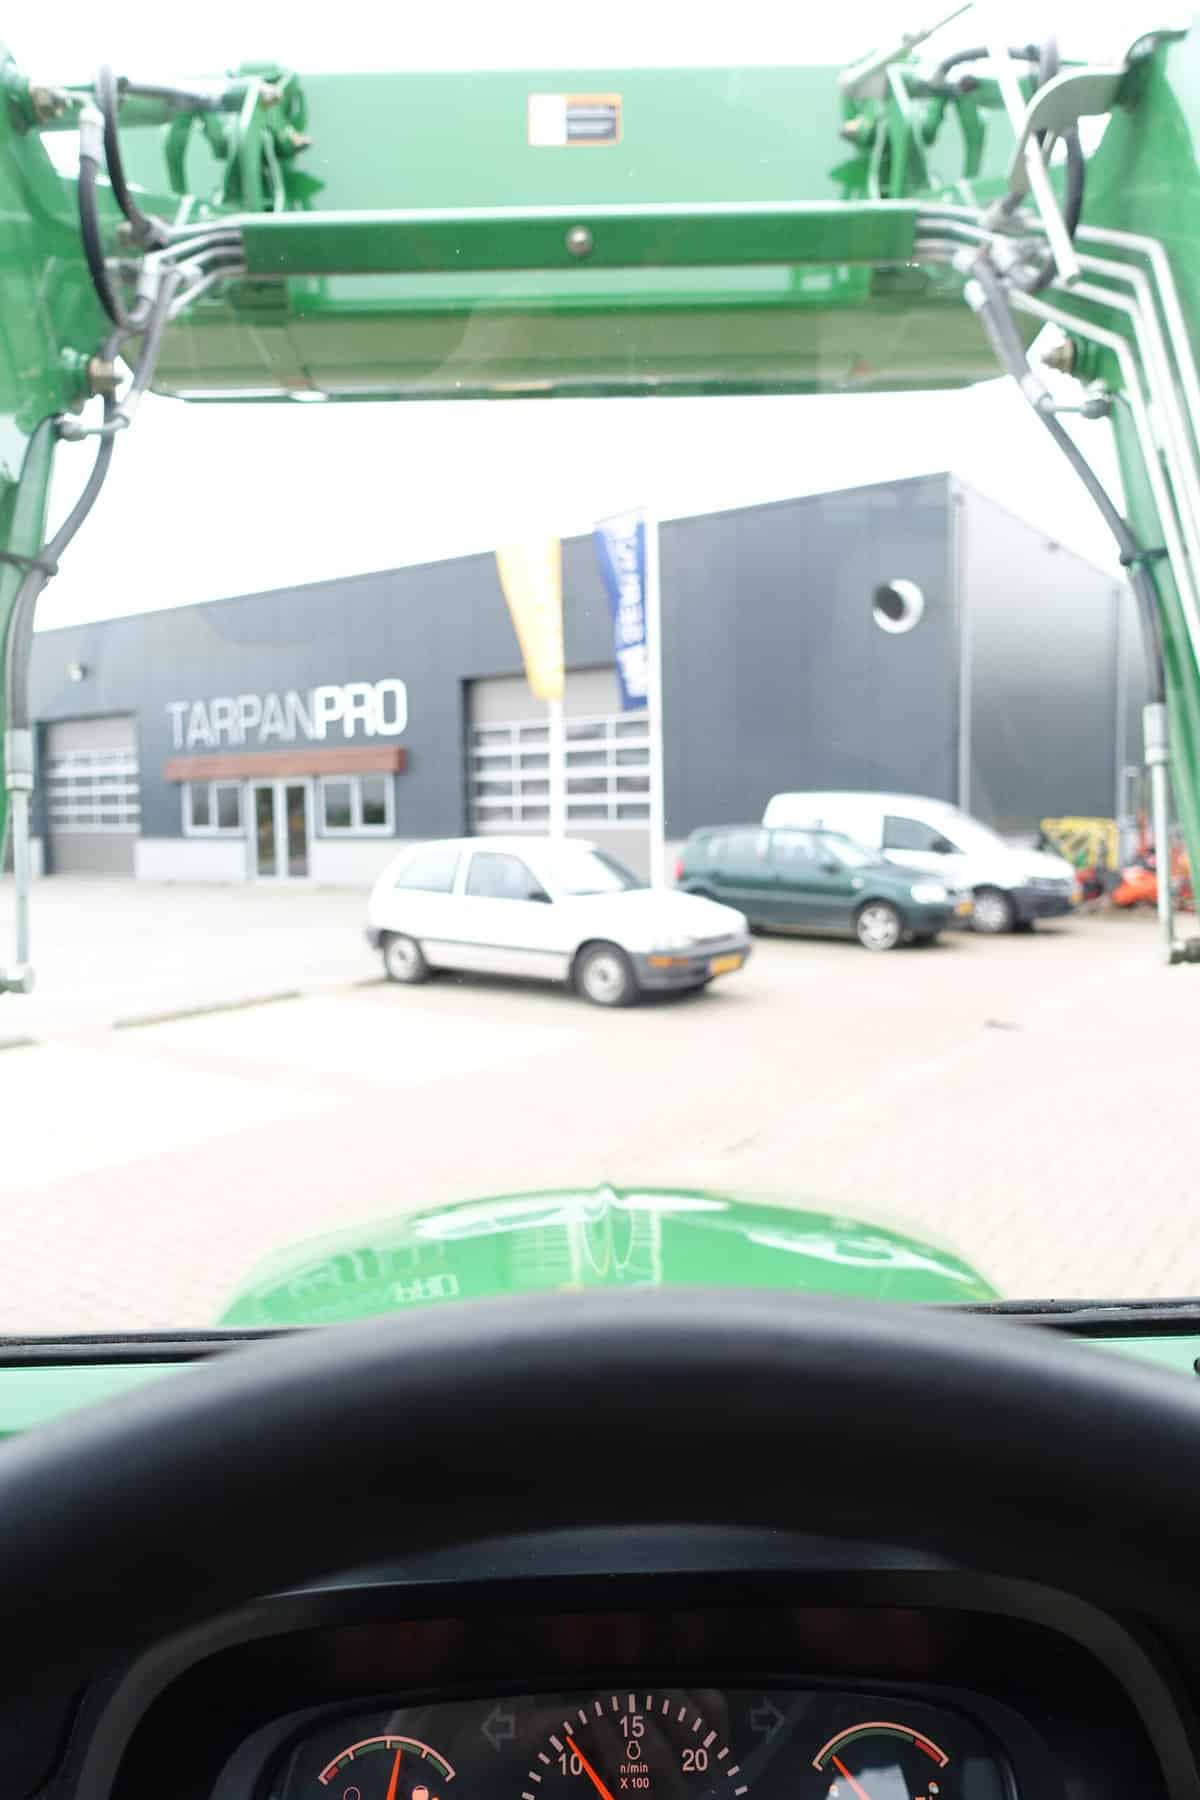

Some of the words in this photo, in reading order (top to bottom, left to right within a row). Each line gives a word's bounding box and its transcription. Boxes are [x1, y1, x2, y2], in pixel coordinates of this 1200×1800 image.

[165, 679, 408, 749] TARPANPRO
[620, 1716, 645, 1738] 15
[558, 1752, 583, 1776] 10
[620, 1762, 648, 1774] n/min
[682, 1749, 708, 1771] 20
[631, 1777, 649, 1789] 100
